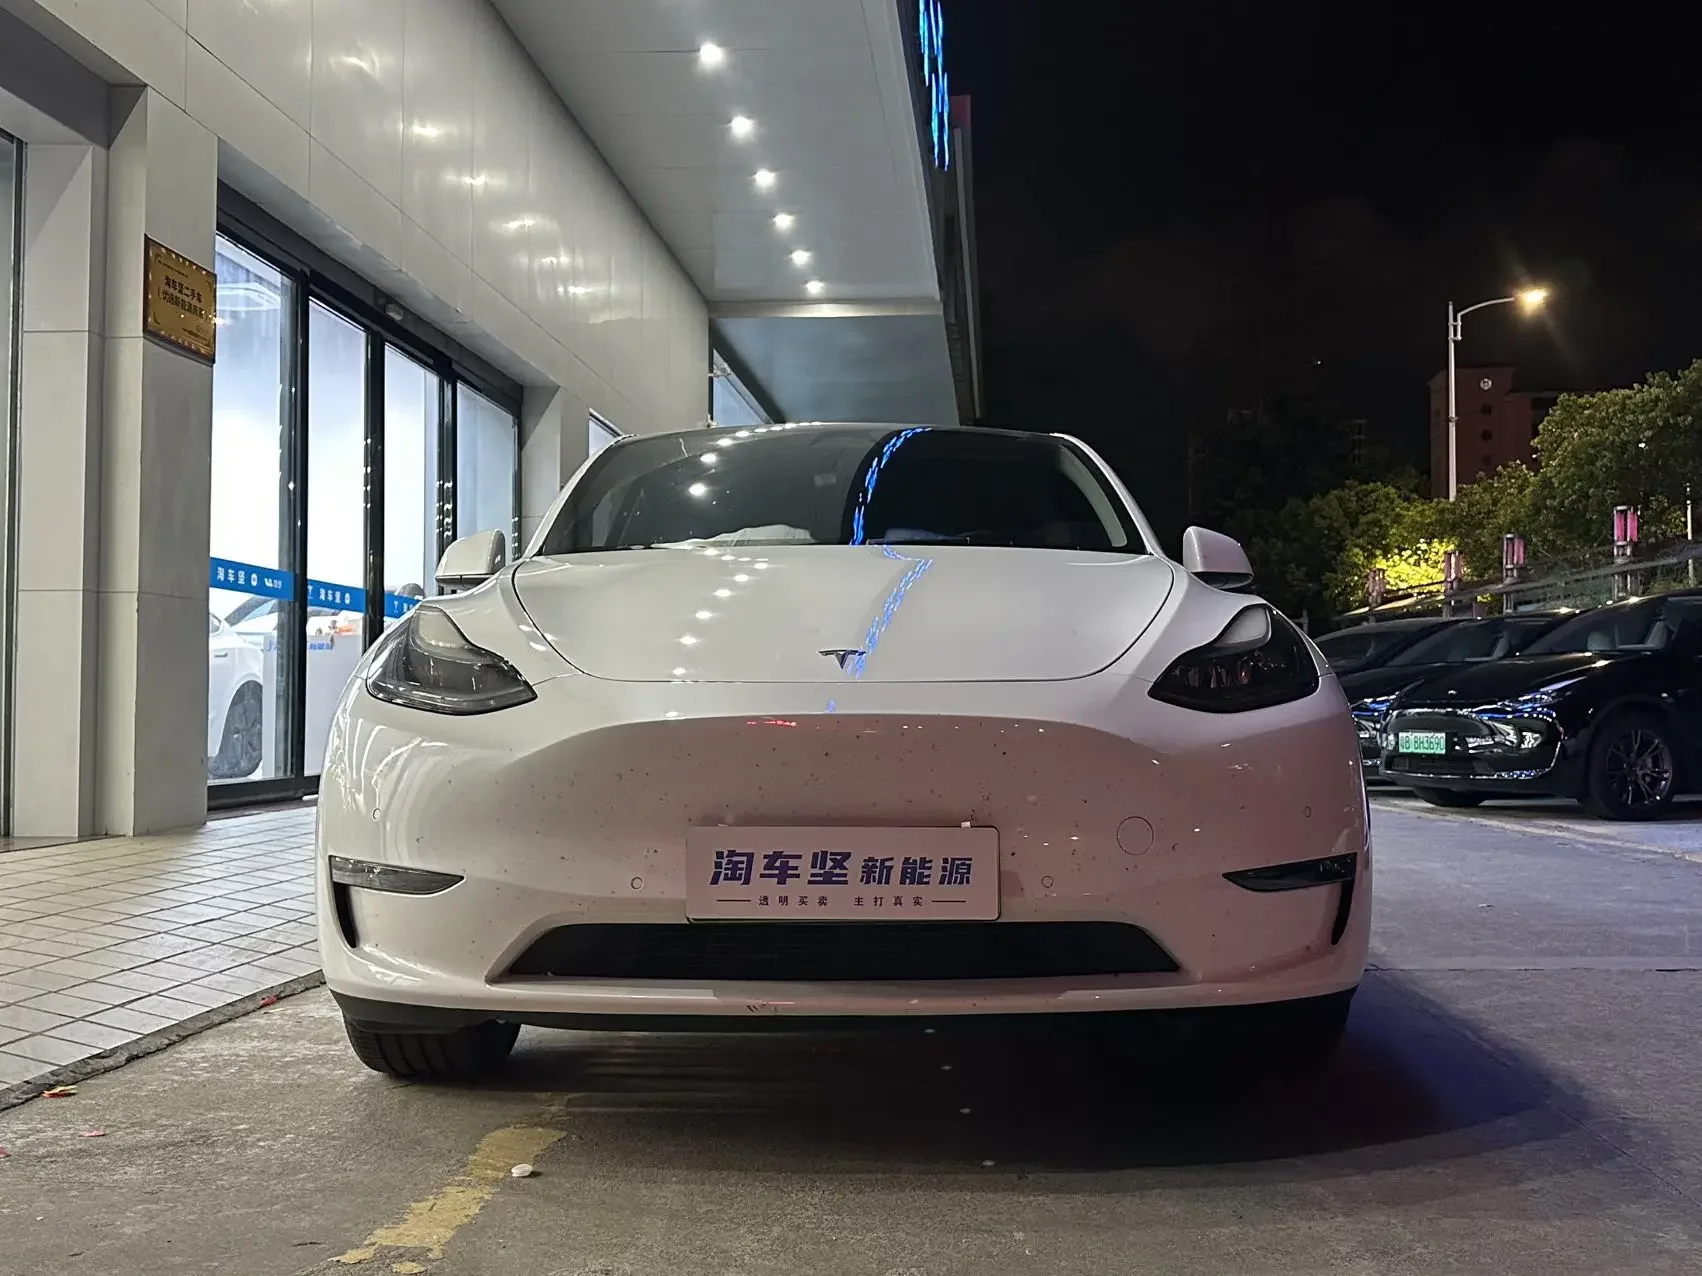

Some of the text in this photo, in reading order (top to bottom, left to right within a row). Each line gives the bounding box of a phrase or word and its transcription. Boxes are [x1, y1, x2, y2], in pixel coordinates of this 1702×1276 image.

[758, 895, 924, 907] 透明买卖 主打真实
